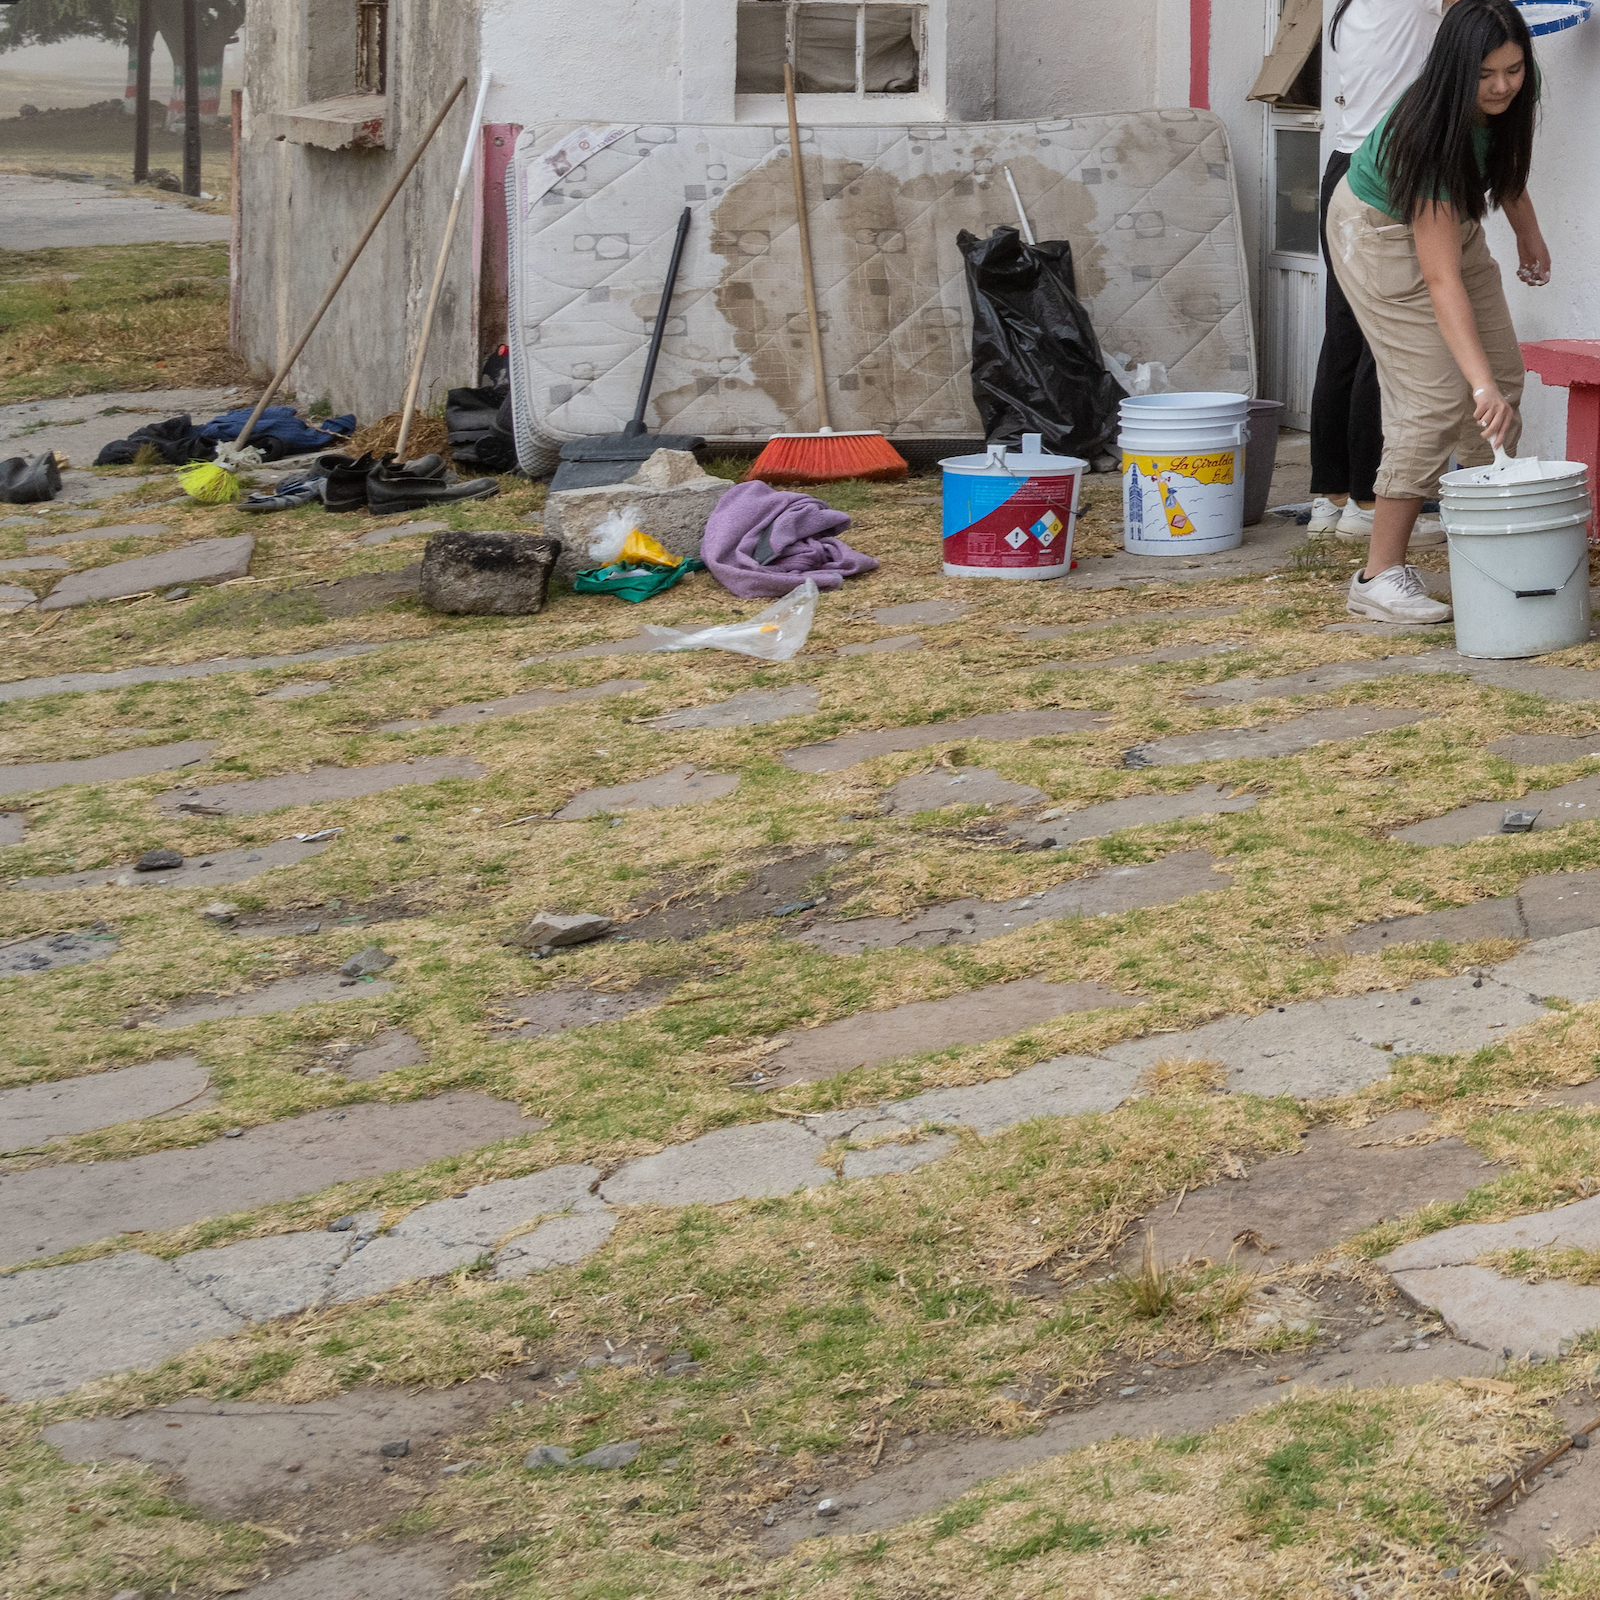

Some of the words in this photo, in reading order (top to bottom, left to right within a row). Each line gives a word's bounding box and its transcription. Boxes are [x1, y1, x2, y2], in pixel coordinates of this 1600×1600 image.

[1170, 456, 1188, 471] La
[1190, 453, 1234, 476] Giralda
[1044, 533, 1051, 542] C
